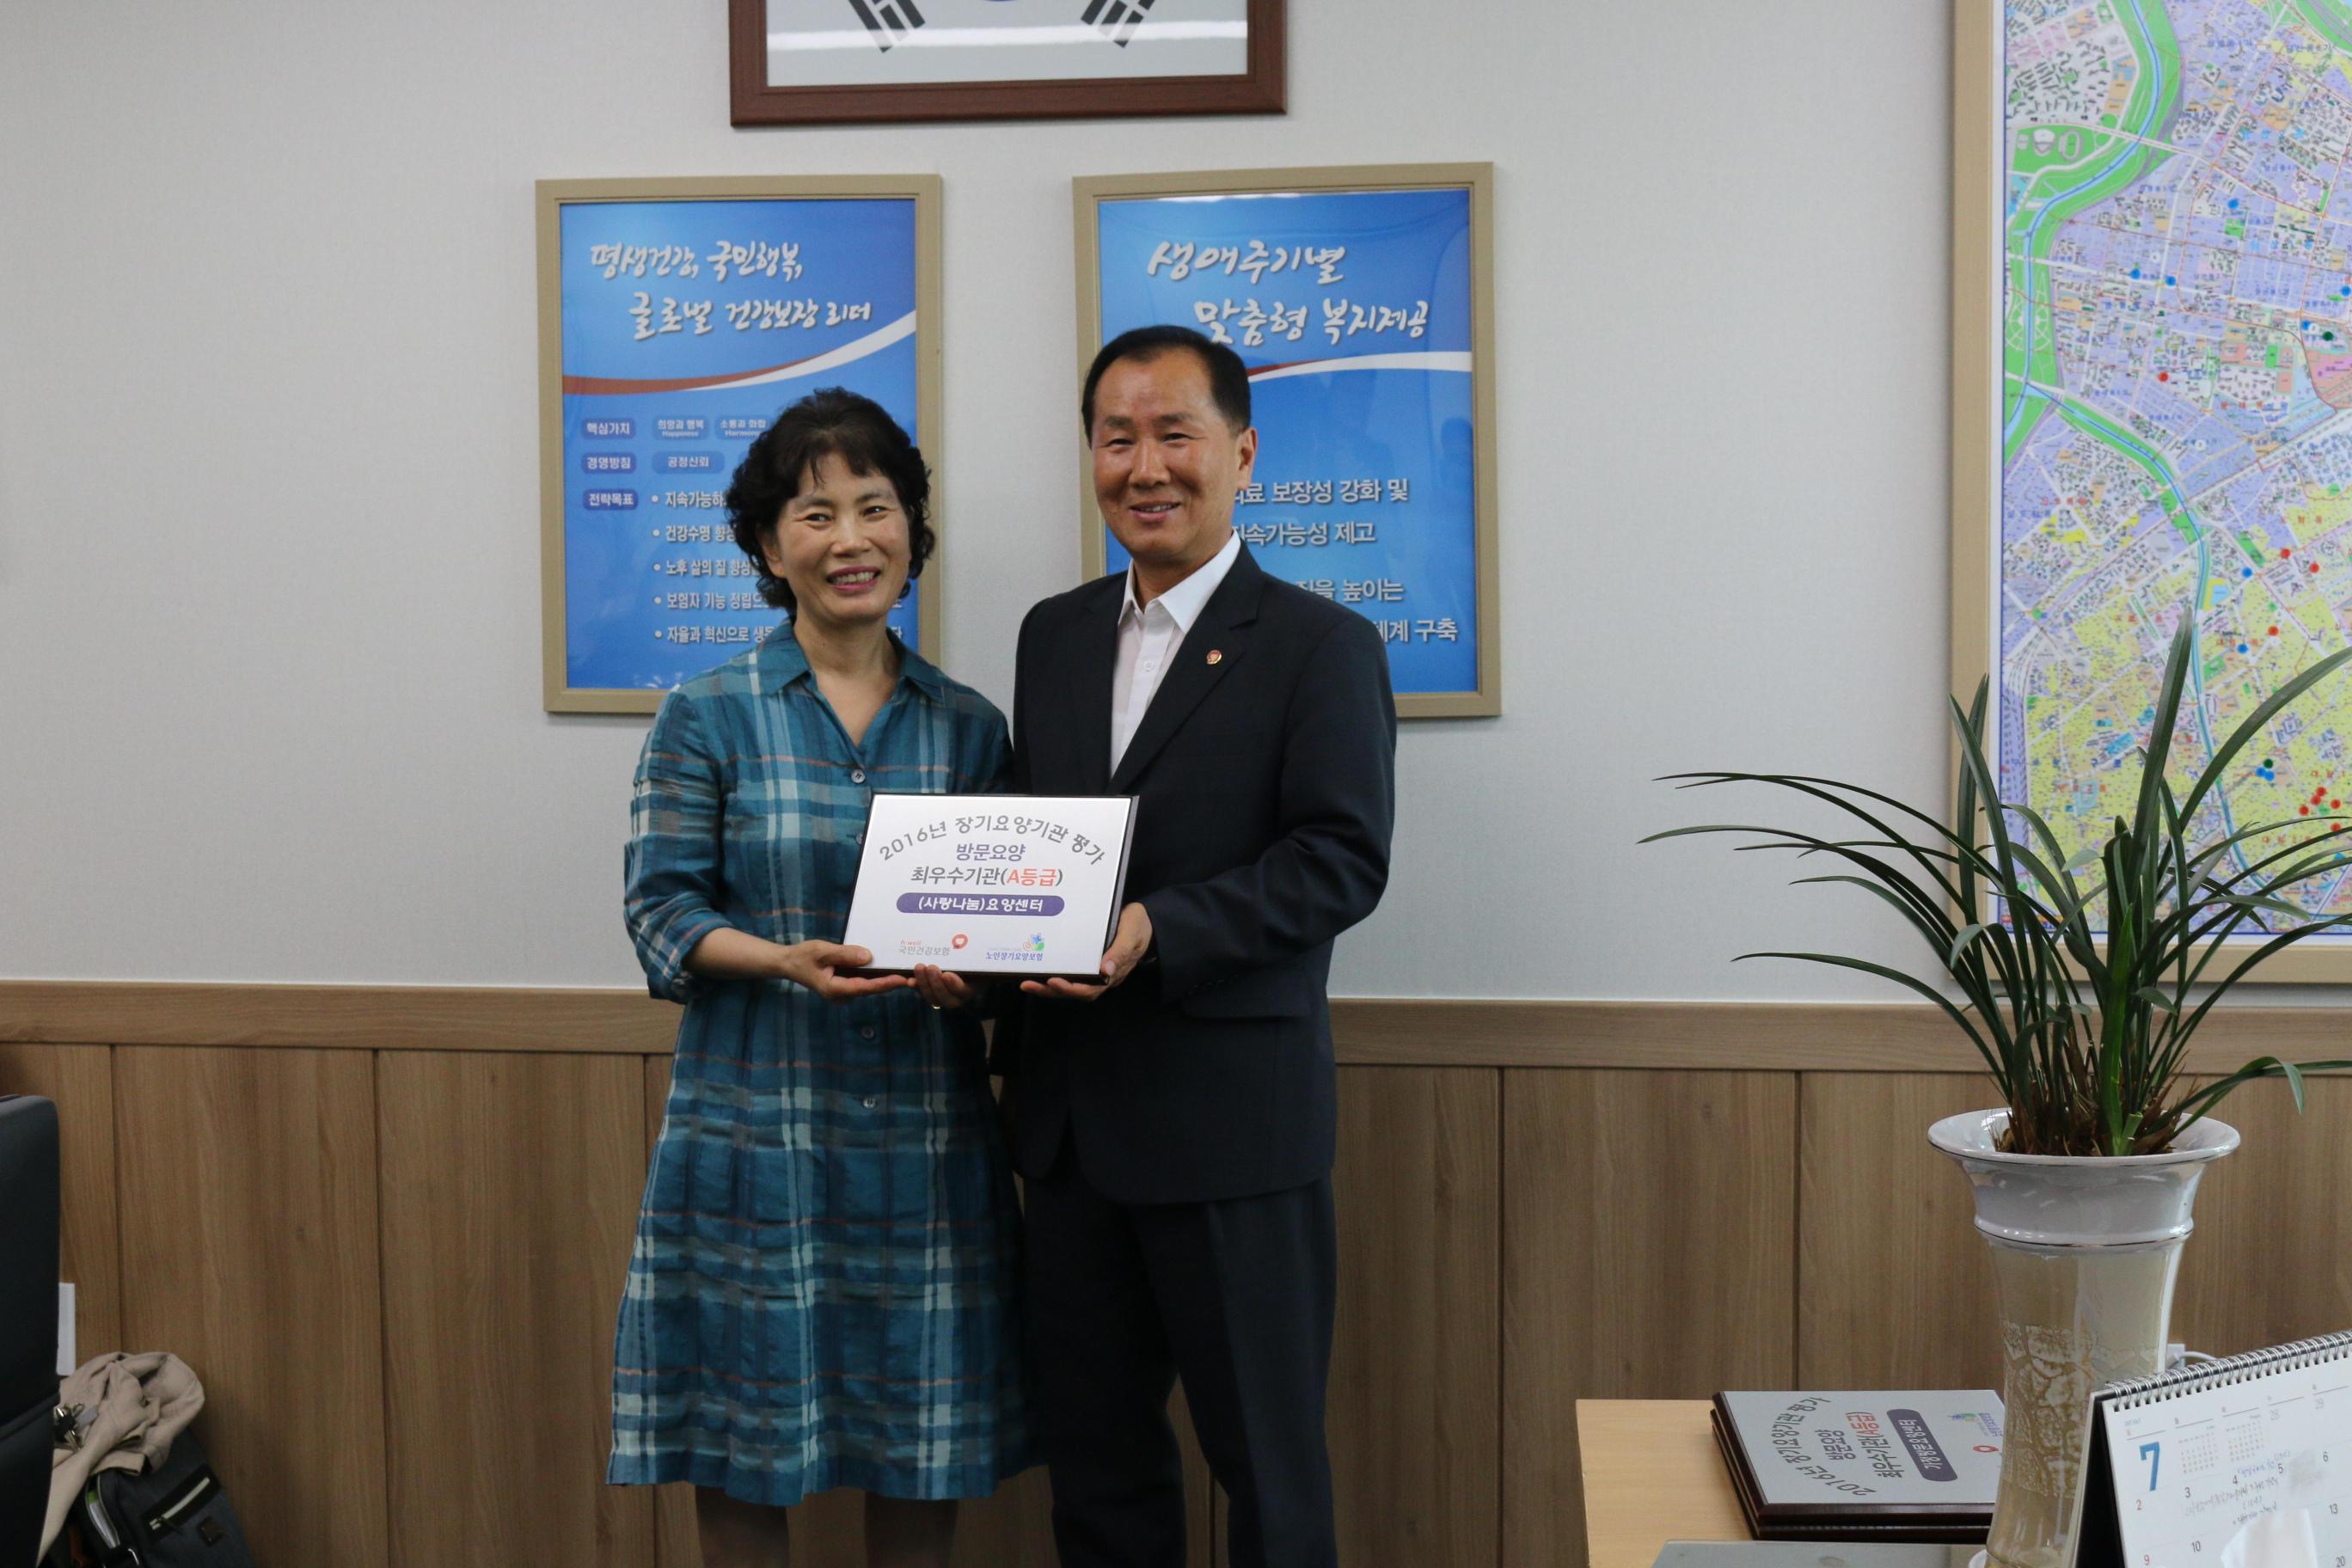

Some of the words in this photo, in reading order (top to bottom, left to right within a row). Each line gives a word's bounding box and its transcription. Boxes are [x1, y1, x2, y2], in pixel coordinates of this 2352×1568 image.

[706, 241, 804, 282] 국민행복,
[1147, 240, 1346, 285] 생애주기별
[628, 292, 713, 340] 글로벌
[726, 298, 819, 330] 건강보장
[825, 302, 872, 325] 리더
[1194, 298, 1308, 345] 맞춤형
[1322, 298, 1430, 344] 복지제공
[586, 422, 630, 435] 핵심가치
[587, 456, 631, 469] 경영방침
[589, 493, 634, 506] 전략목표
[665, 491, 727, 507] 지속가능하
[1271, 481, 1332, 504] 보장성
[1339, 479, 1382, 502] 강화
[1387, 478, 1408, 501] 및
[666, 525, 711, 542] 건강수명
[1335, 523, 1375, 543] 제고
[665, 560, 688, 576] 노후
[690, 560, 713, 576] 삶의
[715, 560, 726, 576] 질
[730, 559, 761, 576] 향상
[667, 593, 700, 609] 보험자
[704, 593, 726, 609] 기능
[731, 592, 769, 609] 정립으
[1341, 579, 1404, 601] 높이는
[667, 627, 701, 643] 자율과
[705, 627, 750, 642] 혁신으로
[1414, 619, 1458, 641] 구축
[879, 821, 946, 861] 2016년
[955, 815, 1069, 843] 장기요양기관
[1071, 834, 1106, 865] 평가
[956, 843, 1026, 861] 방문요양
[910, 866, 1063, 887] 최우수기관(A등급)
[985, 952, 1044, 962] 노인장기요양보험
[1787, 1397, 1831, 1412] 평가
[1772, 1414, 1812, 1463] 장기요양기관
[1815, 1430, 1856, 1460] 방문요양
[1846, 1412, 1904, 1478] 최우수기관(A등급)
[2140, 1442, 2159, 1491] 7
[1797, 1465, 1877, 1496] 2016년
[2136, 1499, 2142, 1510] 2
[2184, 1486, 2191, 1498] 3
[2233, 1475, 2238, 1485] 4
[2277, 1463, 2283, 1473] 5
[2323, 1452, 2329, 1461] 6
[2144, 1554, 2150, 1565] 9
[2191, 1540, 2201, 1553] 10
[2329, 1504, 2338, 1514] 13
[2336, 1556, 2345, 1567] 20
